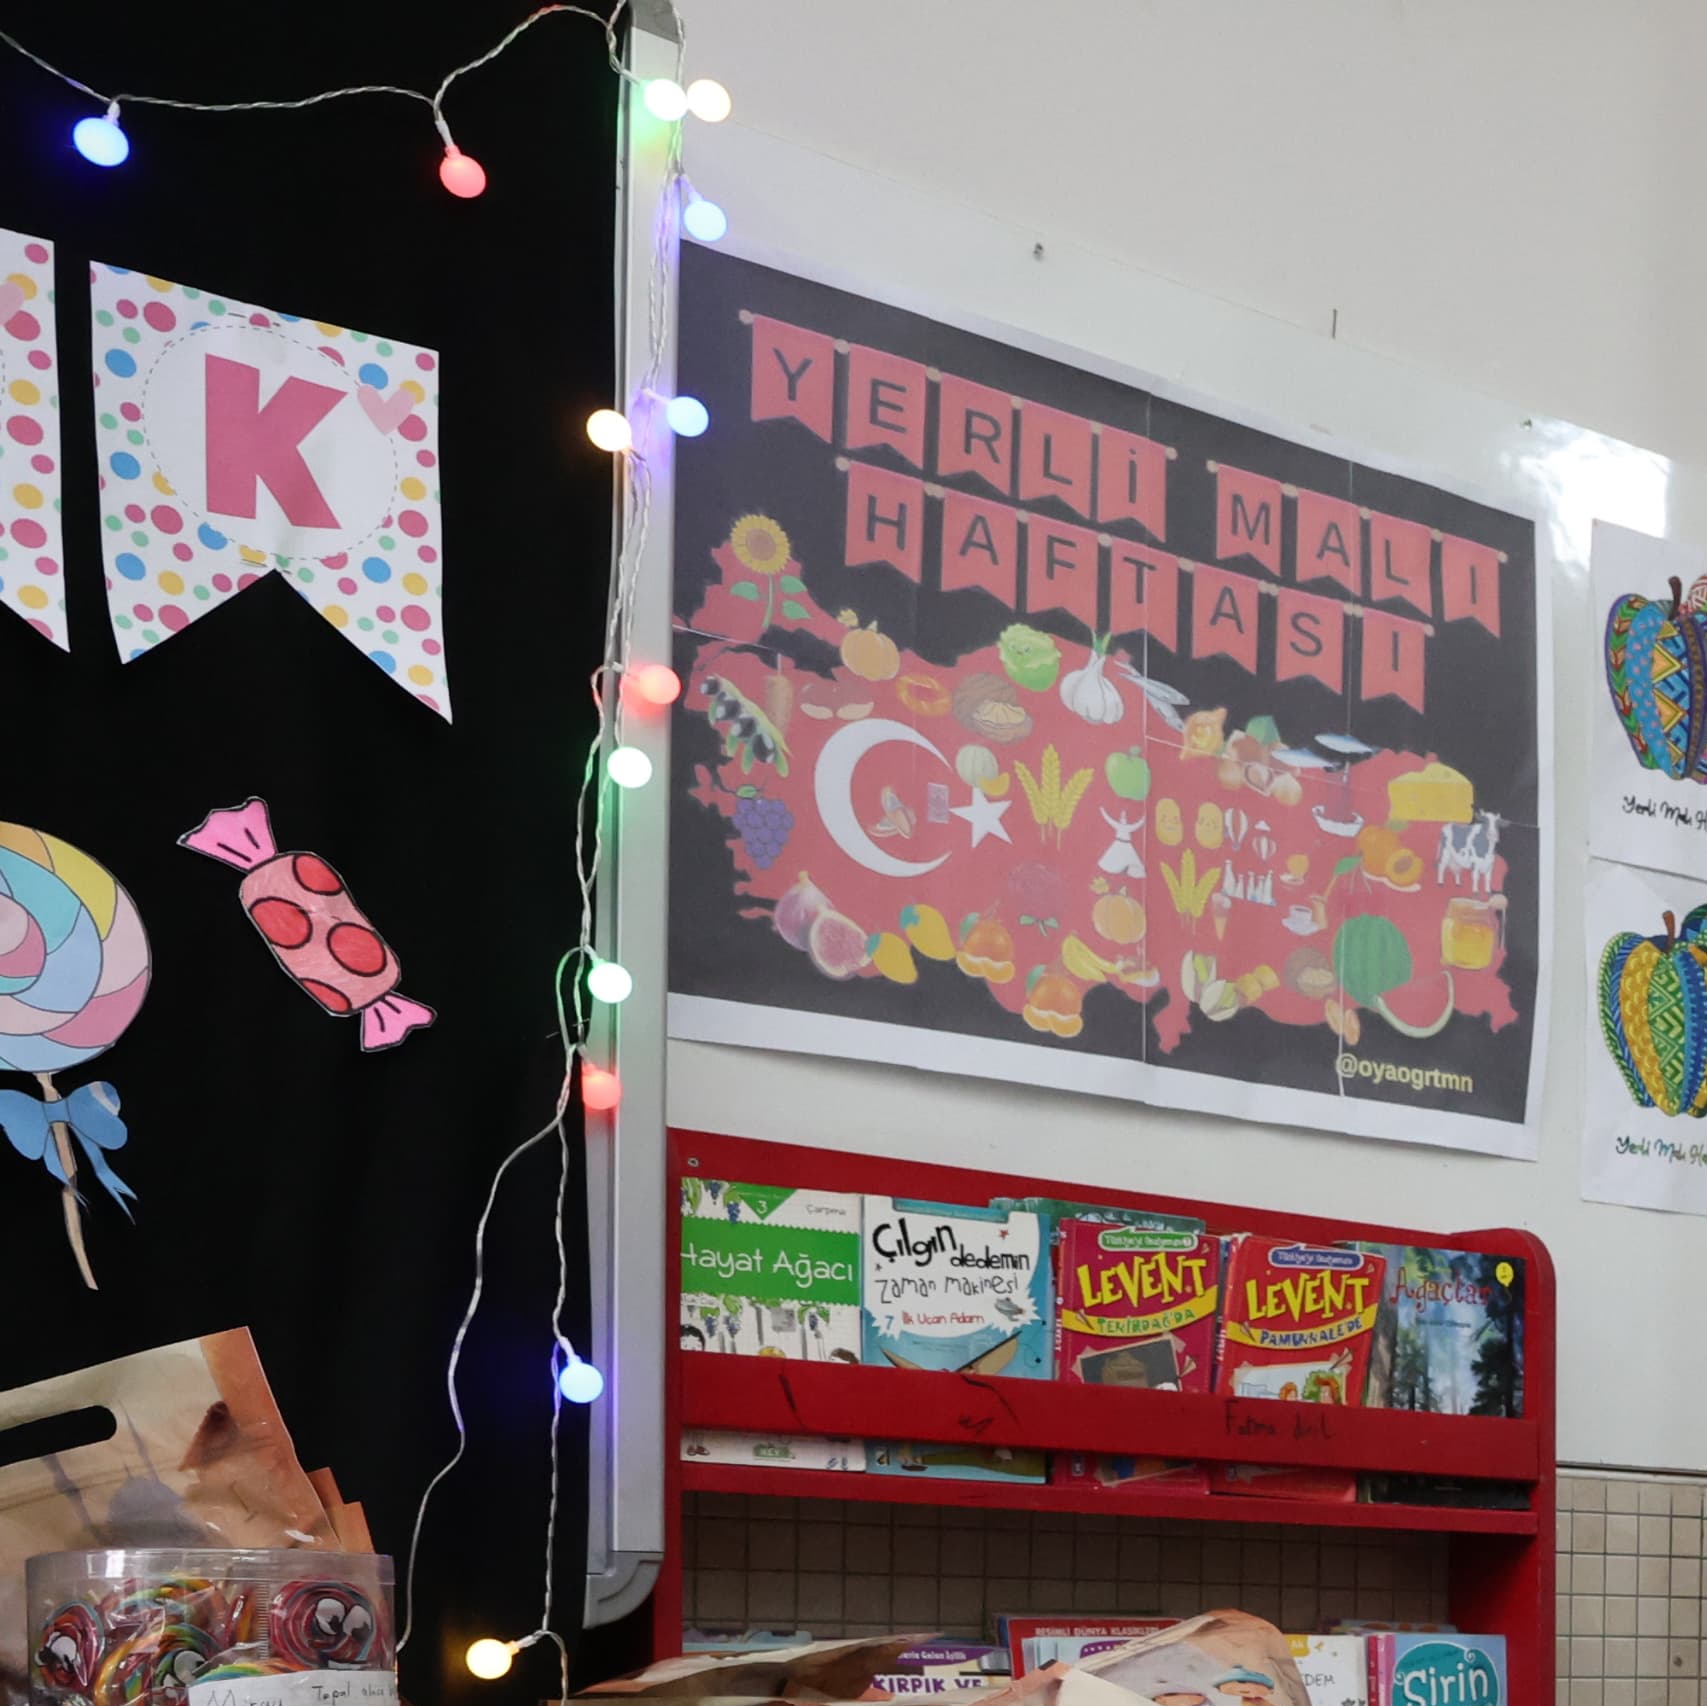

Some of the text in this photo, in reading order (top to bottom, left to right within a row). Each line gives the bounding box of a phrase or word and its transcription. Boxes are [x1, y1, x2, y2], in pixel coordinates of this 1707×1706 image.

[205, 353, 348, 530] K
[774, 346, 1480, 599] YERLİ MALI
[865, 498, 1421, 674] HAFTASI
[1335, 1052, 1474, 1094] @oyaogrtmn
[872, 1217, 958, 1267] Çılgın
[950, 1244, 1031, 1271] dedemin
[772, 1252, 854, 1289] Ağacı
[1076, 1251, 1207, 1309] LEVENT
[1245, 1269, 1370, 1323] LEVENT
